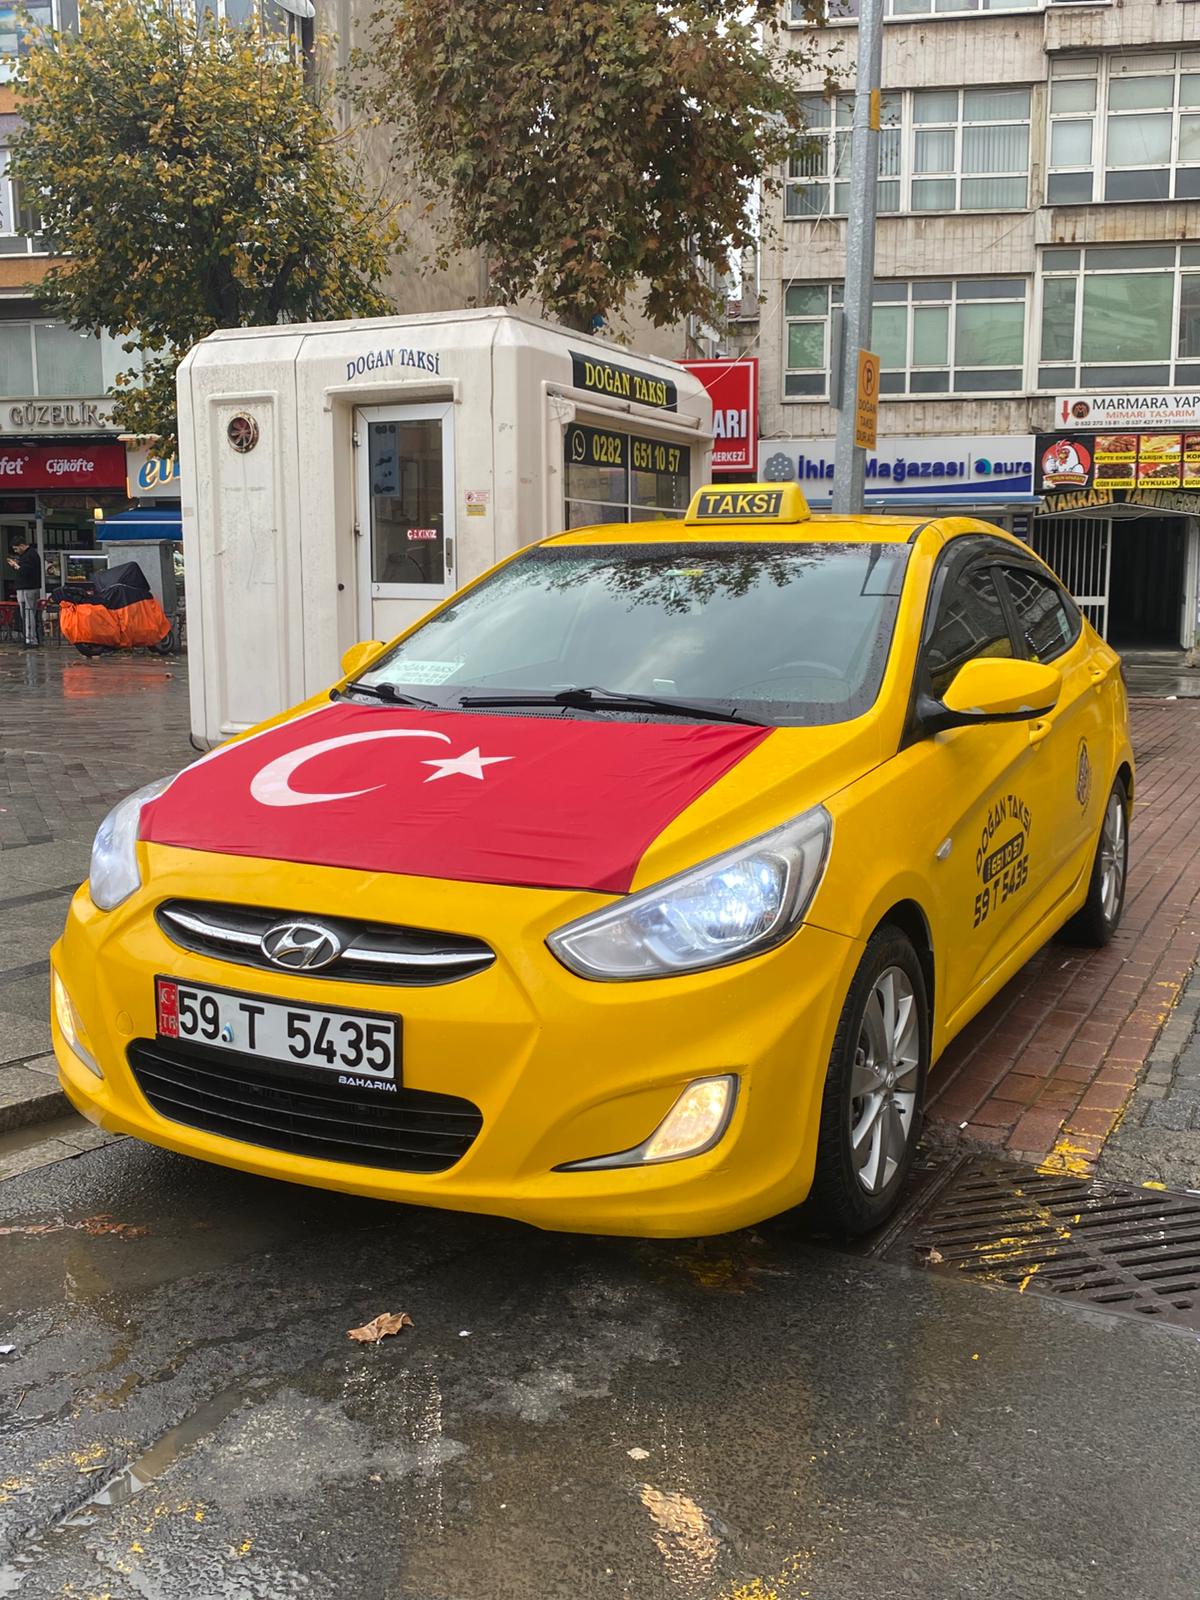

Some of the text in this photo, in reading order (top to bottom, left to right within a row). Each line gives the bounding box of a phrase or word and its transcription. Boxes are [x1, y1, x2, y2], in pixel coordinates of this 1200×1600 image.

[585, 362, 667, 405] DOĞAN TAKSİ
[1092, 397, 1168, 410] MARMARA
[1149, 410, 1195, 418] TASARIM
[713, 409, 747, 438] ARI
[46, 458, 94, 476] Çiğköfte
[592, 434, 681, 473] 0282 651 10 57
[798, 455, 1032, 482] İhla Mağazası aura
[973, 887, 990, 929] 59
[993, 877, 1001, 910] T
[1001, 854, 1029, 904] 5435
[161, 1013, 177, 1030] TR
[178, 989, 392, 1073] 59 T 5435
[338, 1075, 398, 1092] BAHARIM
